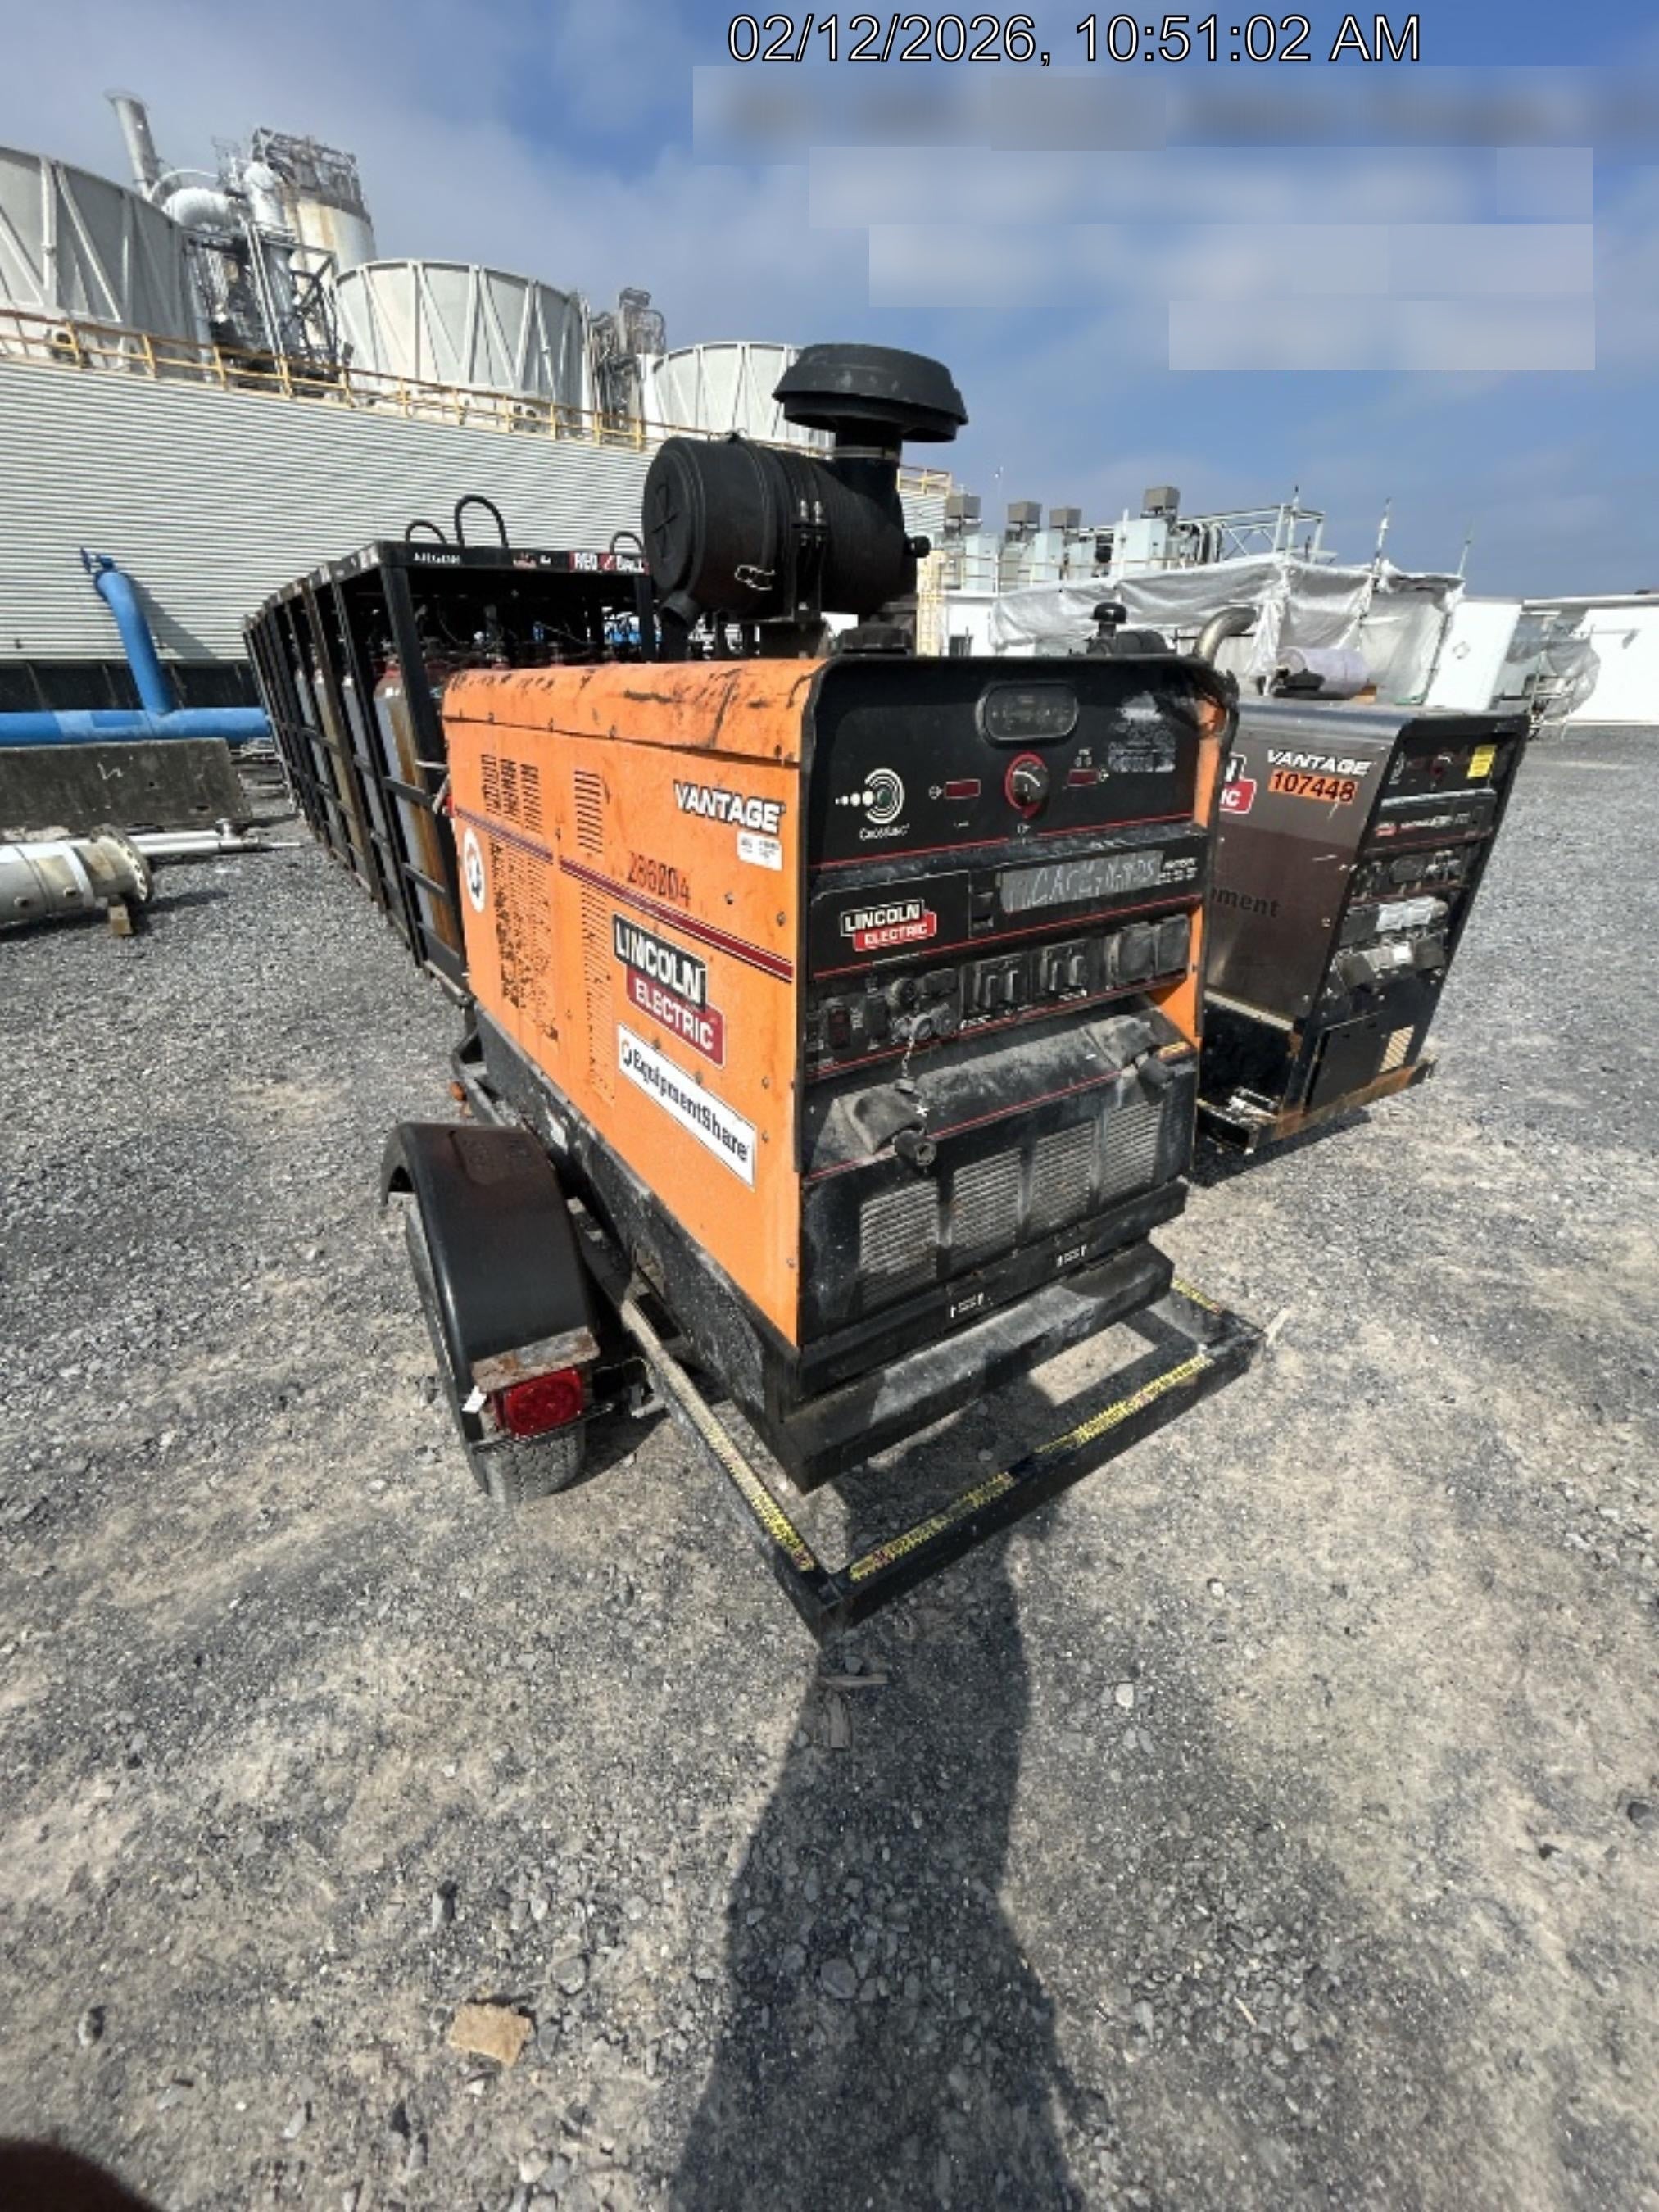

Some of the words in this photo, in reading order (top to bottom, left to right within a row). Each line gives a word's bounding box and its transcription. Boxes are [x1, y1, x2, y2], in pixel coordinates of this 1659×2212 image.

[1267, 749, 1373, 776] VANTAGE
[673, 781, 781, 835] VANTAGE
[1272, 771, 1356, 803] 107448
[845, 904, 920, 932] LINCOLN
[864, 923, 927, 945] ELECTRIC
[616, 921, 701, 1004] LINCOLN
[634, 977, 714, 1050] ELECTRIC
[633, 1048, 748, 1163] EquipmentShare
